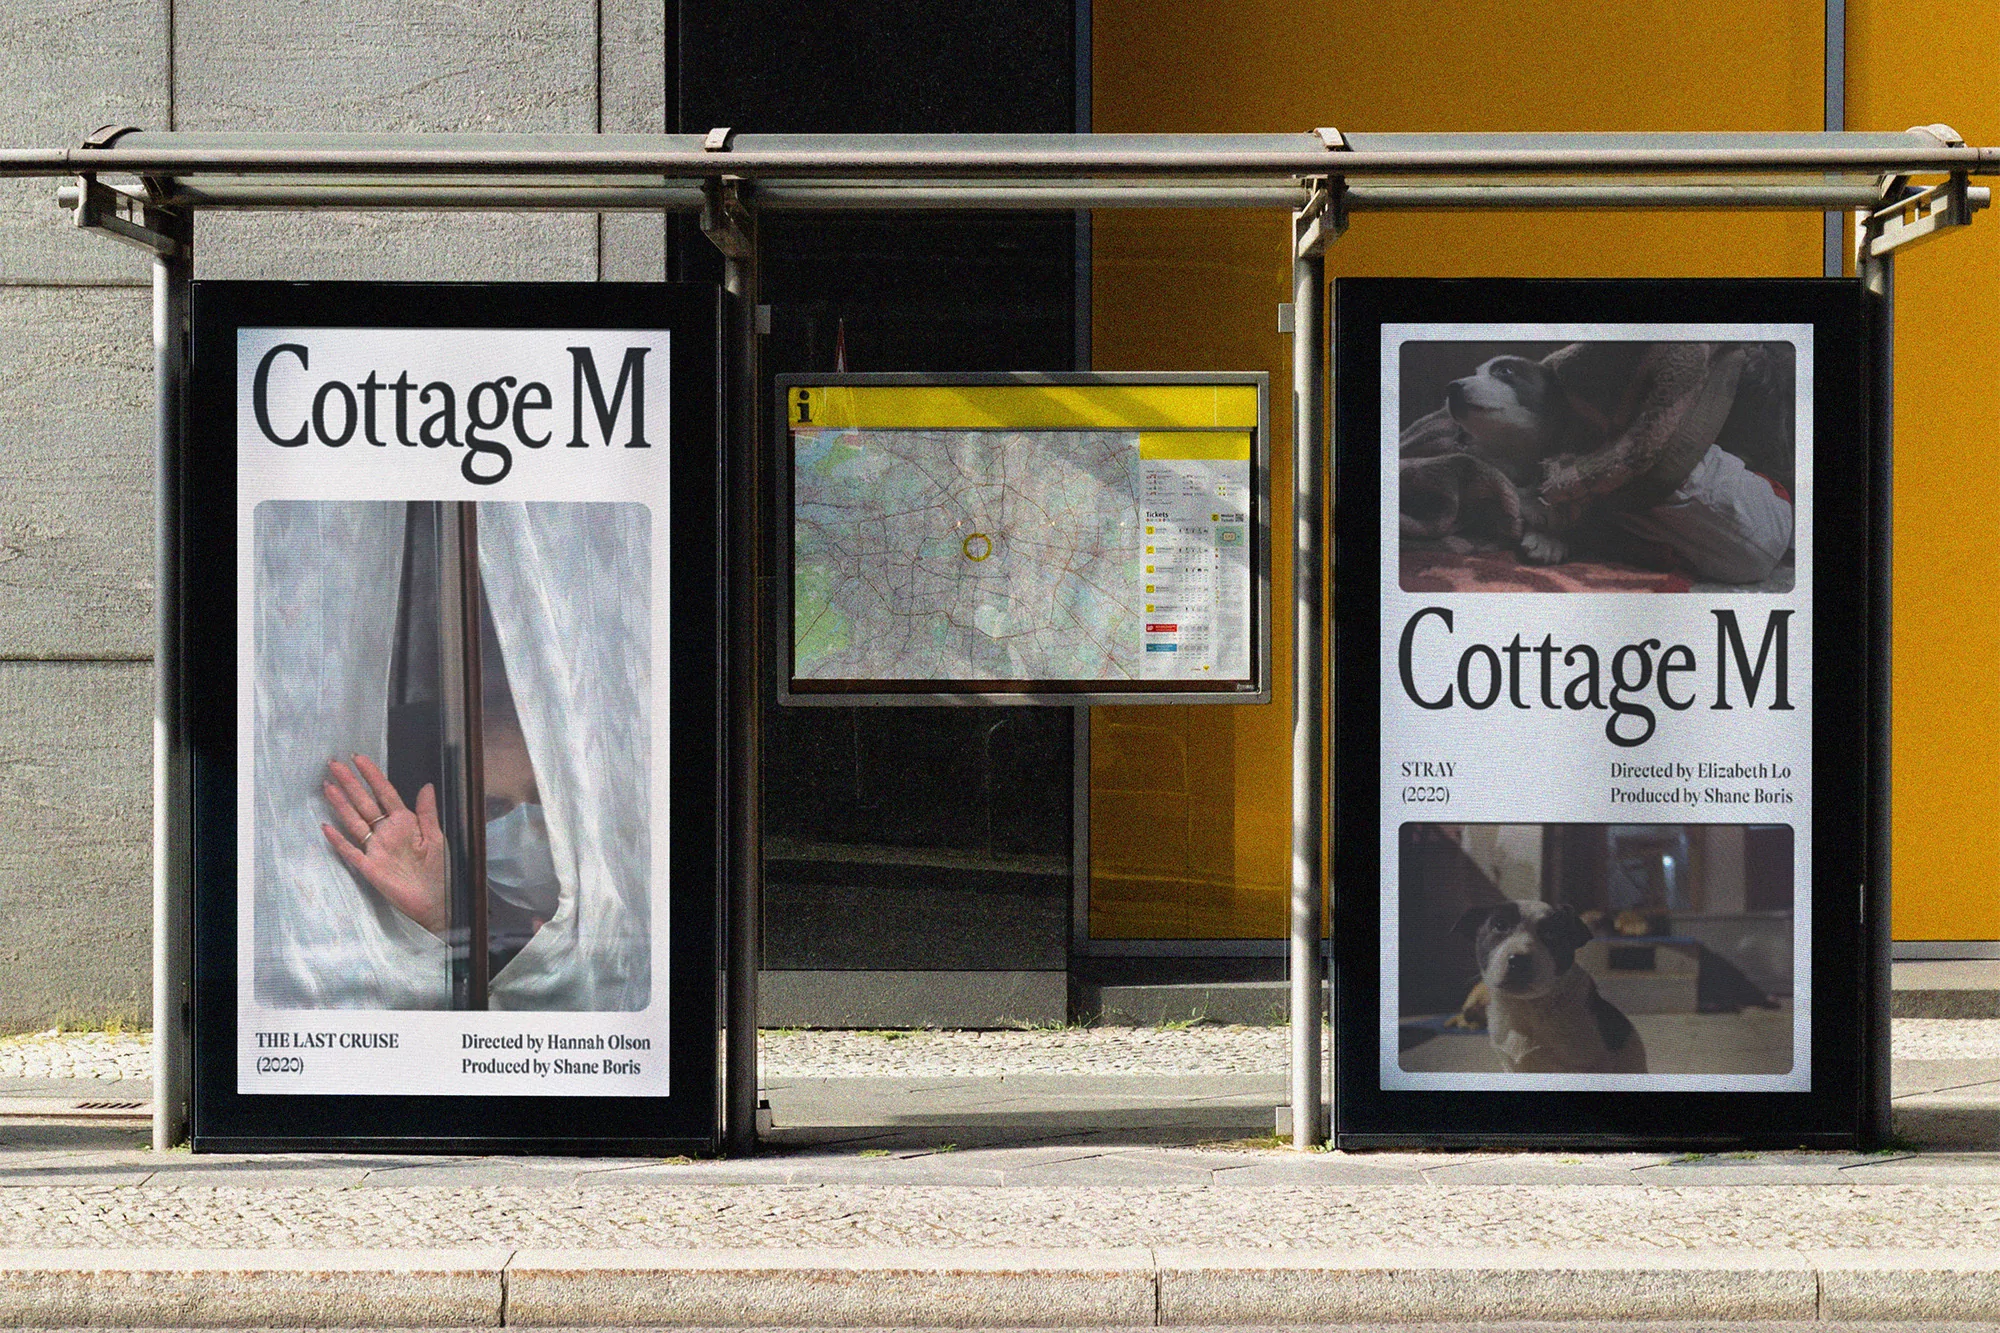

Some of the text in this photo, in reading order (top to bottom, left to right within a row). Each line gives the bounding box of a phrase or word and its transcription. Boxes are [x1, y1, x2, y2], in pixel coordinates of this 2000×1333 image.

[252, 342, 652, 486] Cottage M
[1397, 606, 1796, 748] Cottage M
[1401, 761, 1457, 778] STRAY
[1610, 761, 1792, 783] Directed by Elizabeth Lo
[1401, 785, 1451, 805] (2020)
[1610, 786, 1794, 808] Produced by Shane Boris
[255, 1032, 400, 1049] THE LAST CRUISE
[461, 1033, 652, 1054] Directed by Hannah Olson
[256, 1056, 305, 1076] (2020)
[461, 1057, 642, 1079] Produced by Shane Boris
